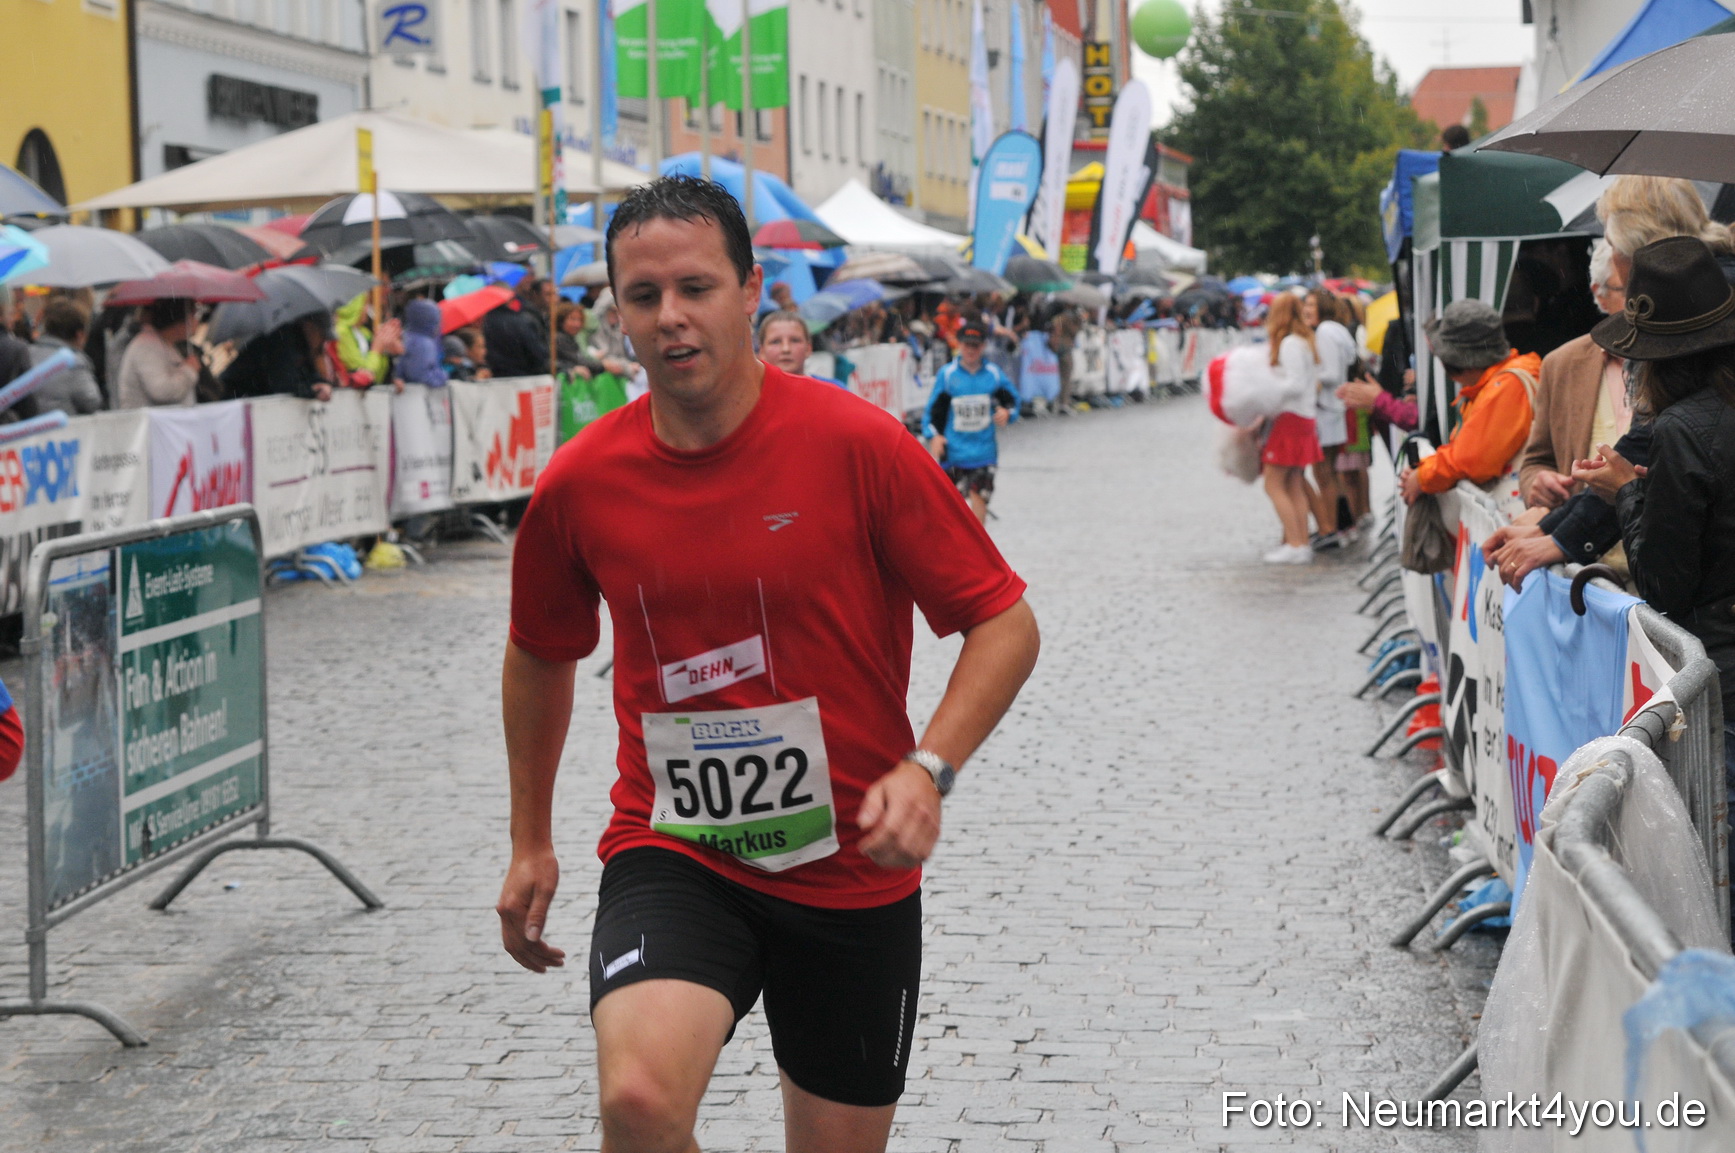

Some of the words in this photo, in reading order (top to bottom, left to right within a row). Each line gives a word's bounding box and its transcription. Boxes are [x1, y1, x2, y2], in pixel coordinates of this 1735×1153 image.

[126, 666, 150, 712] Fun
[152, 658, 164, 702] &
[164, 648, 204, 698] Action
[204, 643, 218, 684] in
[689, 656, 734, 685] DEHN
[127, 725, 179, 777] sicheren
[180, 698, 228, 755] Bahnen!
[691, 718, 763, 740] BOCK
[666, 747, 814, 820] 5022
[698, 828, 787, 855] Markus
